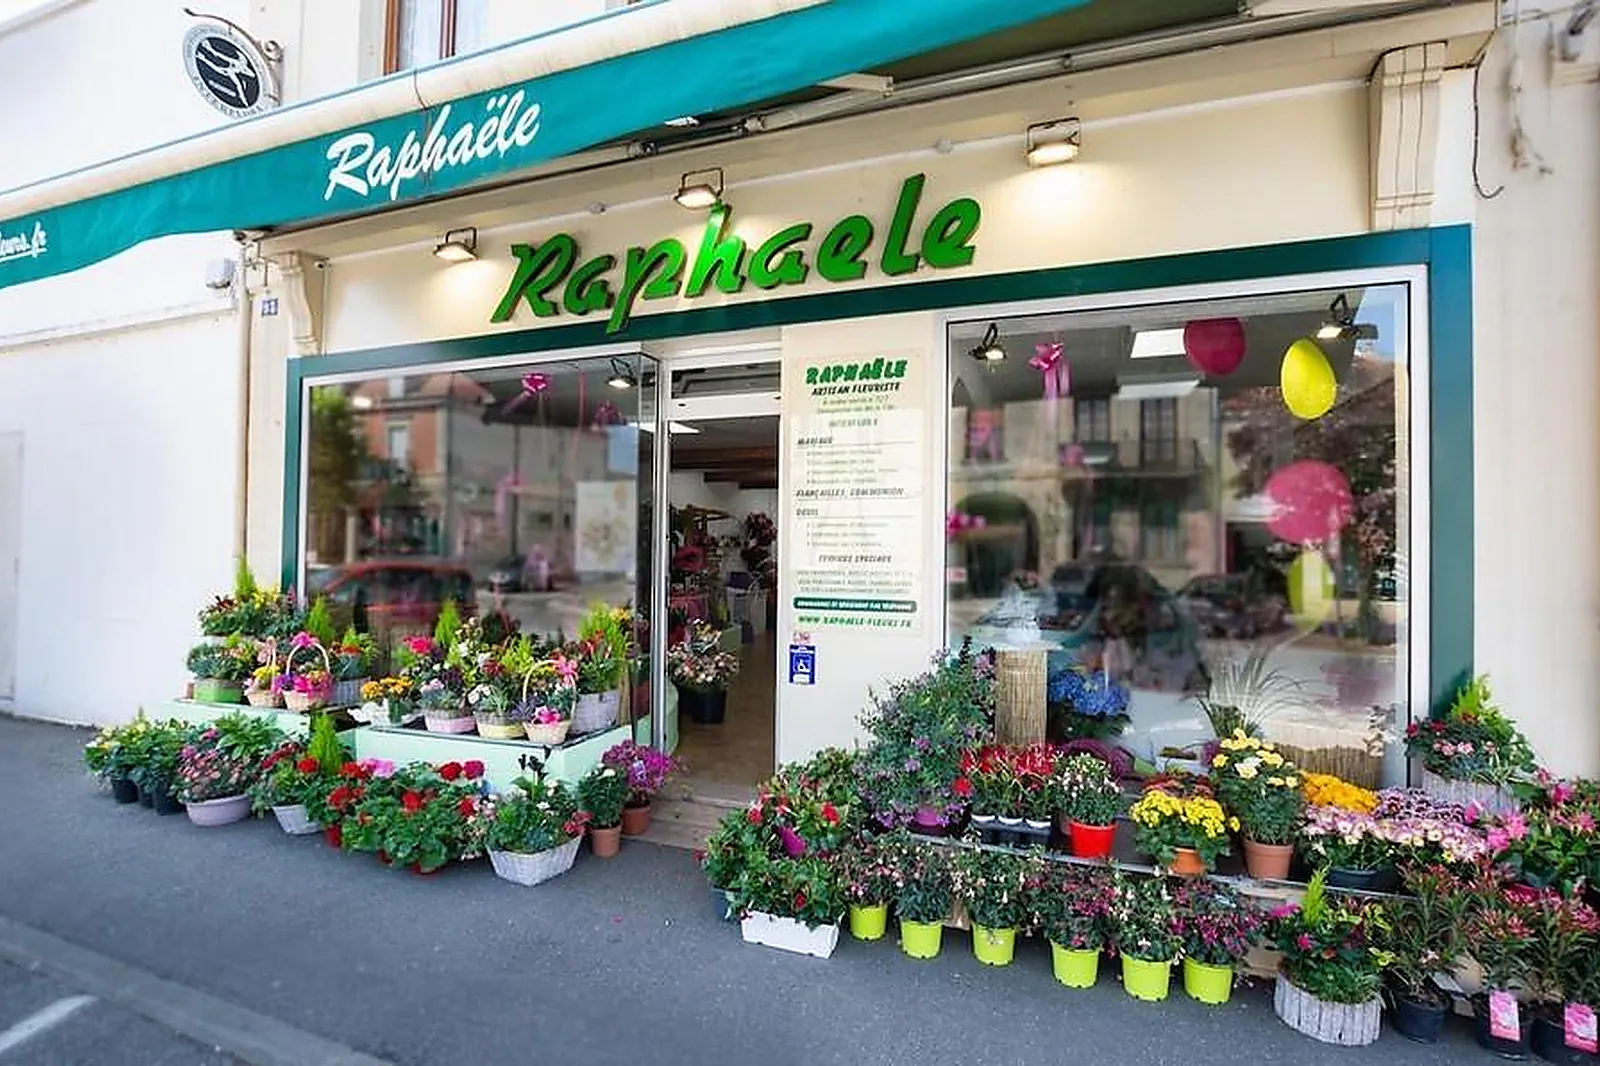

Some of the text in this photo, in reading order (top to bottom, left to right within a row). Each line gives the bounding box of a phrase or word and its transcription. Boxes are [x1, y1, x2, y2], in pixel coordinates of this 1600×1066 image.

[324, 89, 540, 200] Raphaële
[490, 173, 981, 334] Raphaele
[806, 357, 908, 385] RAPHAËLE
[812, 382, 901, 396] ARTISAN FLEURISTE
